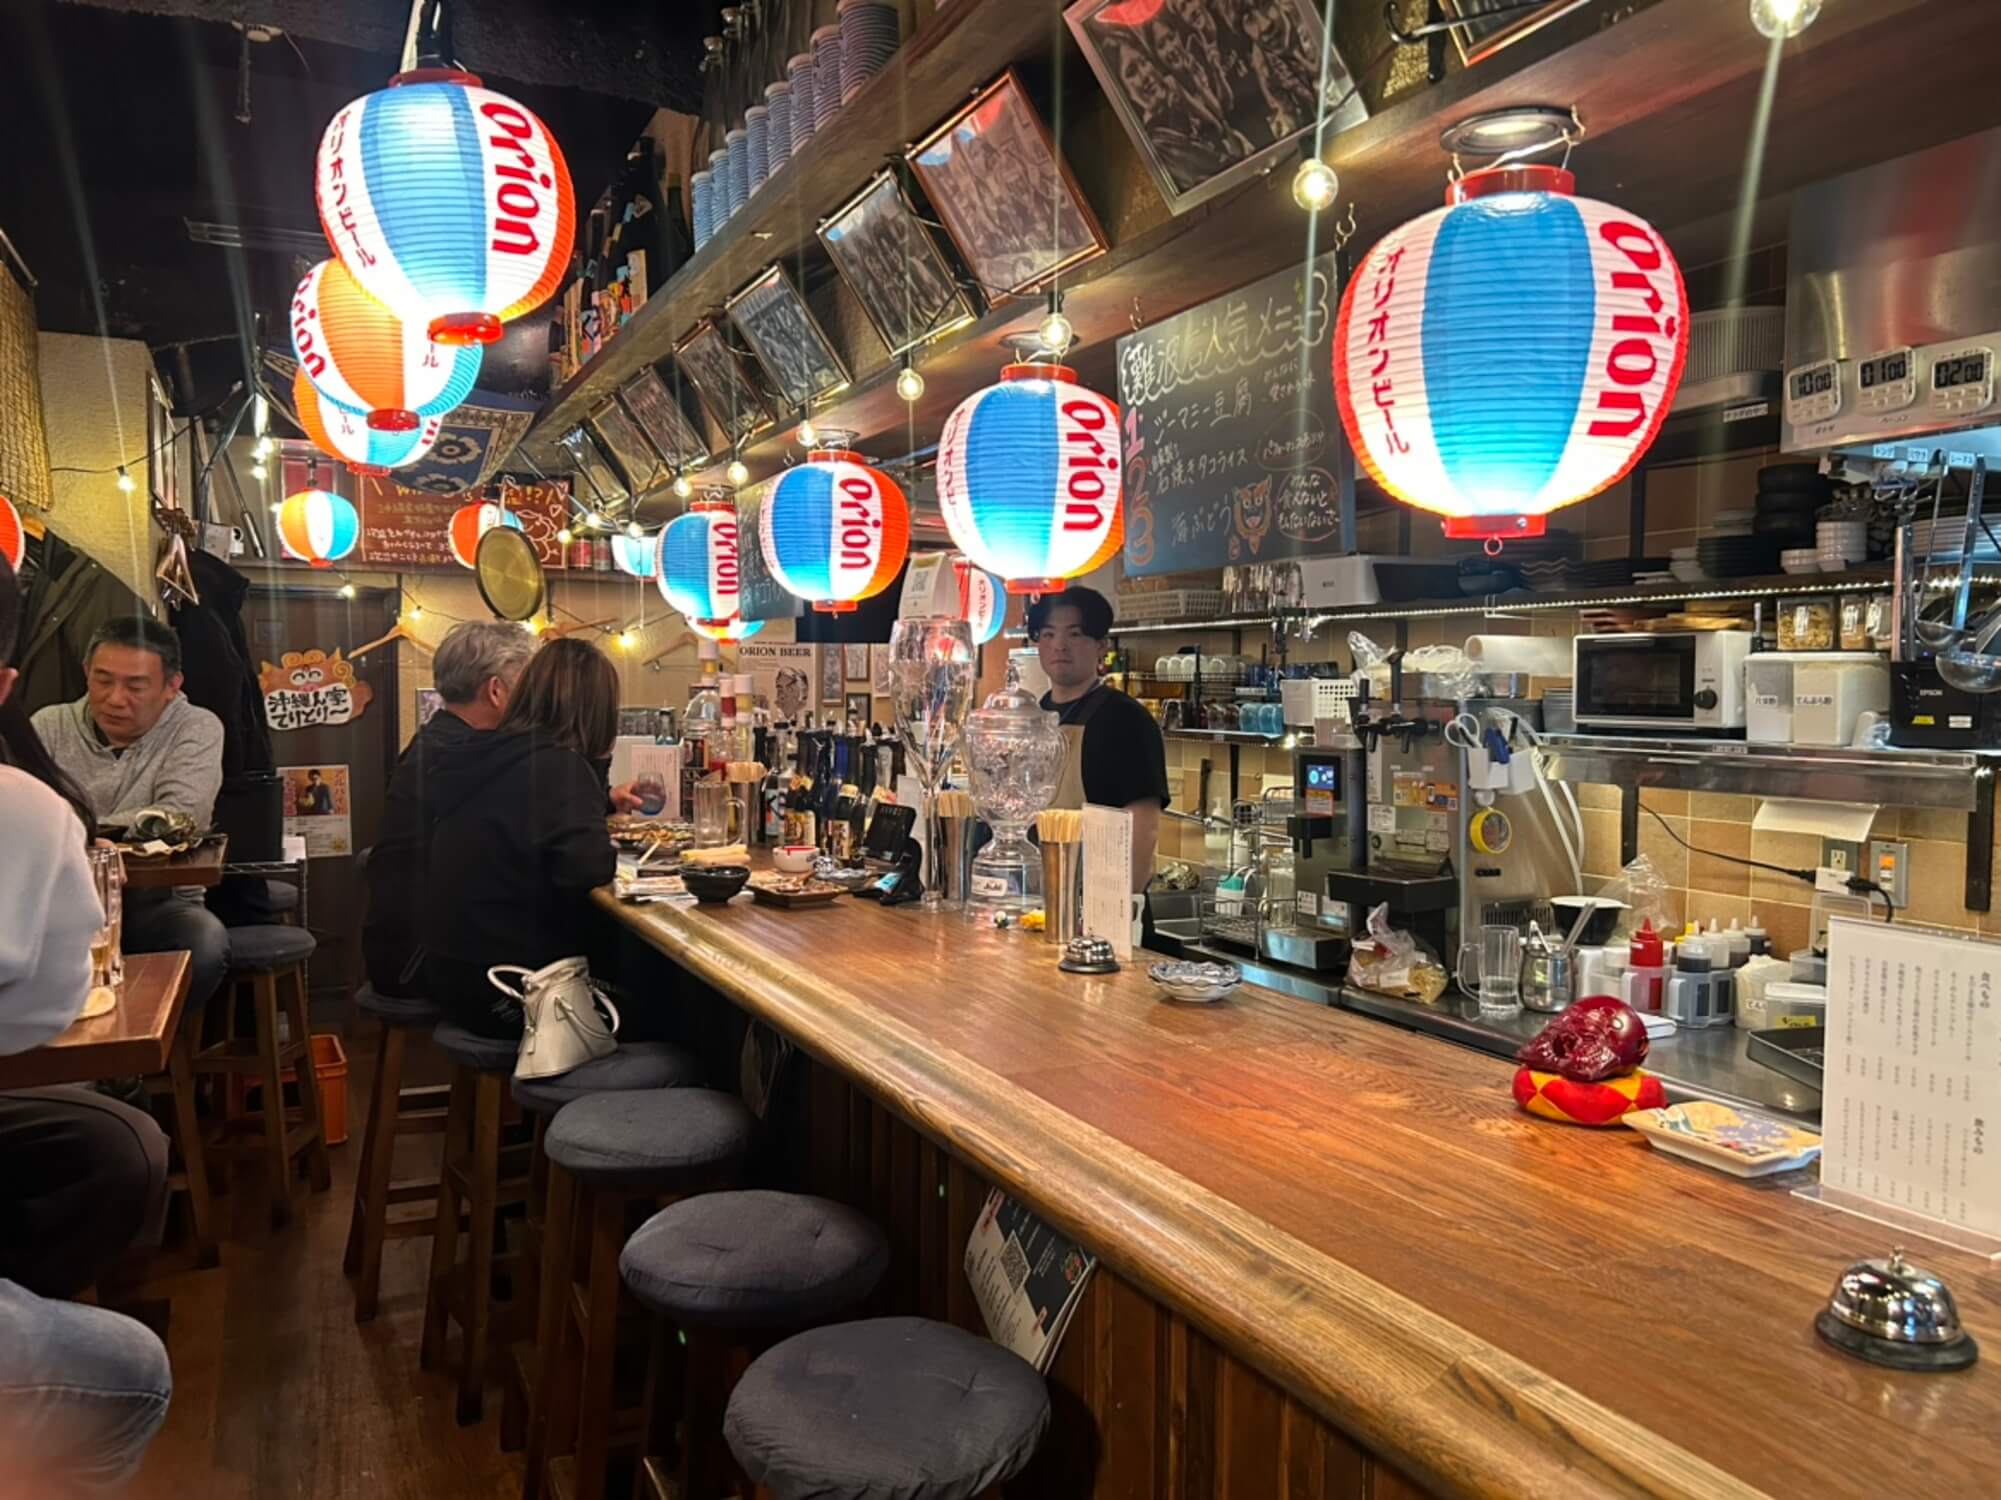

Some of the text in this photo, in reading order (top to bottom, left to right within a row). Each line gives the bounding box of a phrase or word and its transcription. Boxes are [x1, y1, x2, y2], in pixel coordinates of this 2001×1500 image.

[1368, 246, 1410, 457] オリオンビール
[739, 646, 811, 657] ORION BEER
[1919, 689, 1943, 697] EPSON
